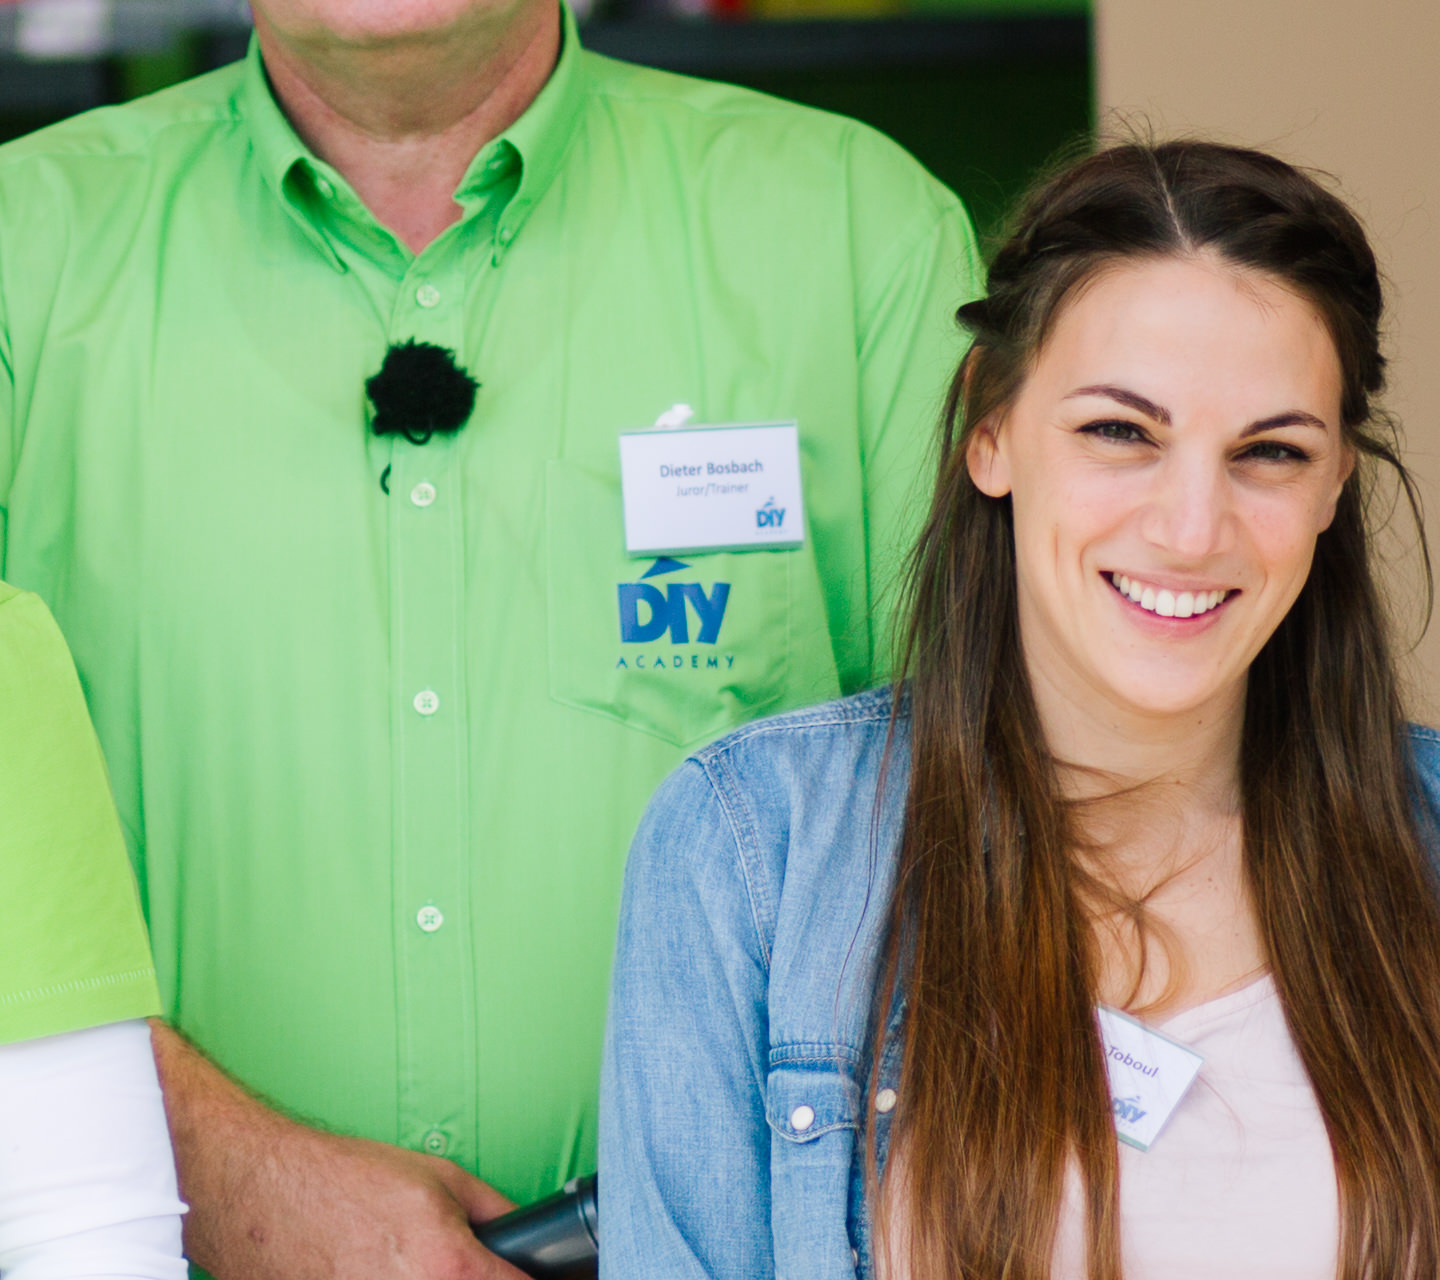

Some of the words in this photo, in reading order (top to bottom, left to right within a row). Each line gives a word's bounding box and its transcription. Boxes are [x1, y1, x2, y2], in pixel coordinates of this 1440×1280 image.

[659, 463, 702, 478] Dieter
[707, 459, 764, 476] Bosbach
[755, 508, 786, 528] DIY
[617, 582, 731, 645] DIY
[616, 654, 735, 670] ACADEMY
[1108, 1046, 1158, 1077] Toboul
